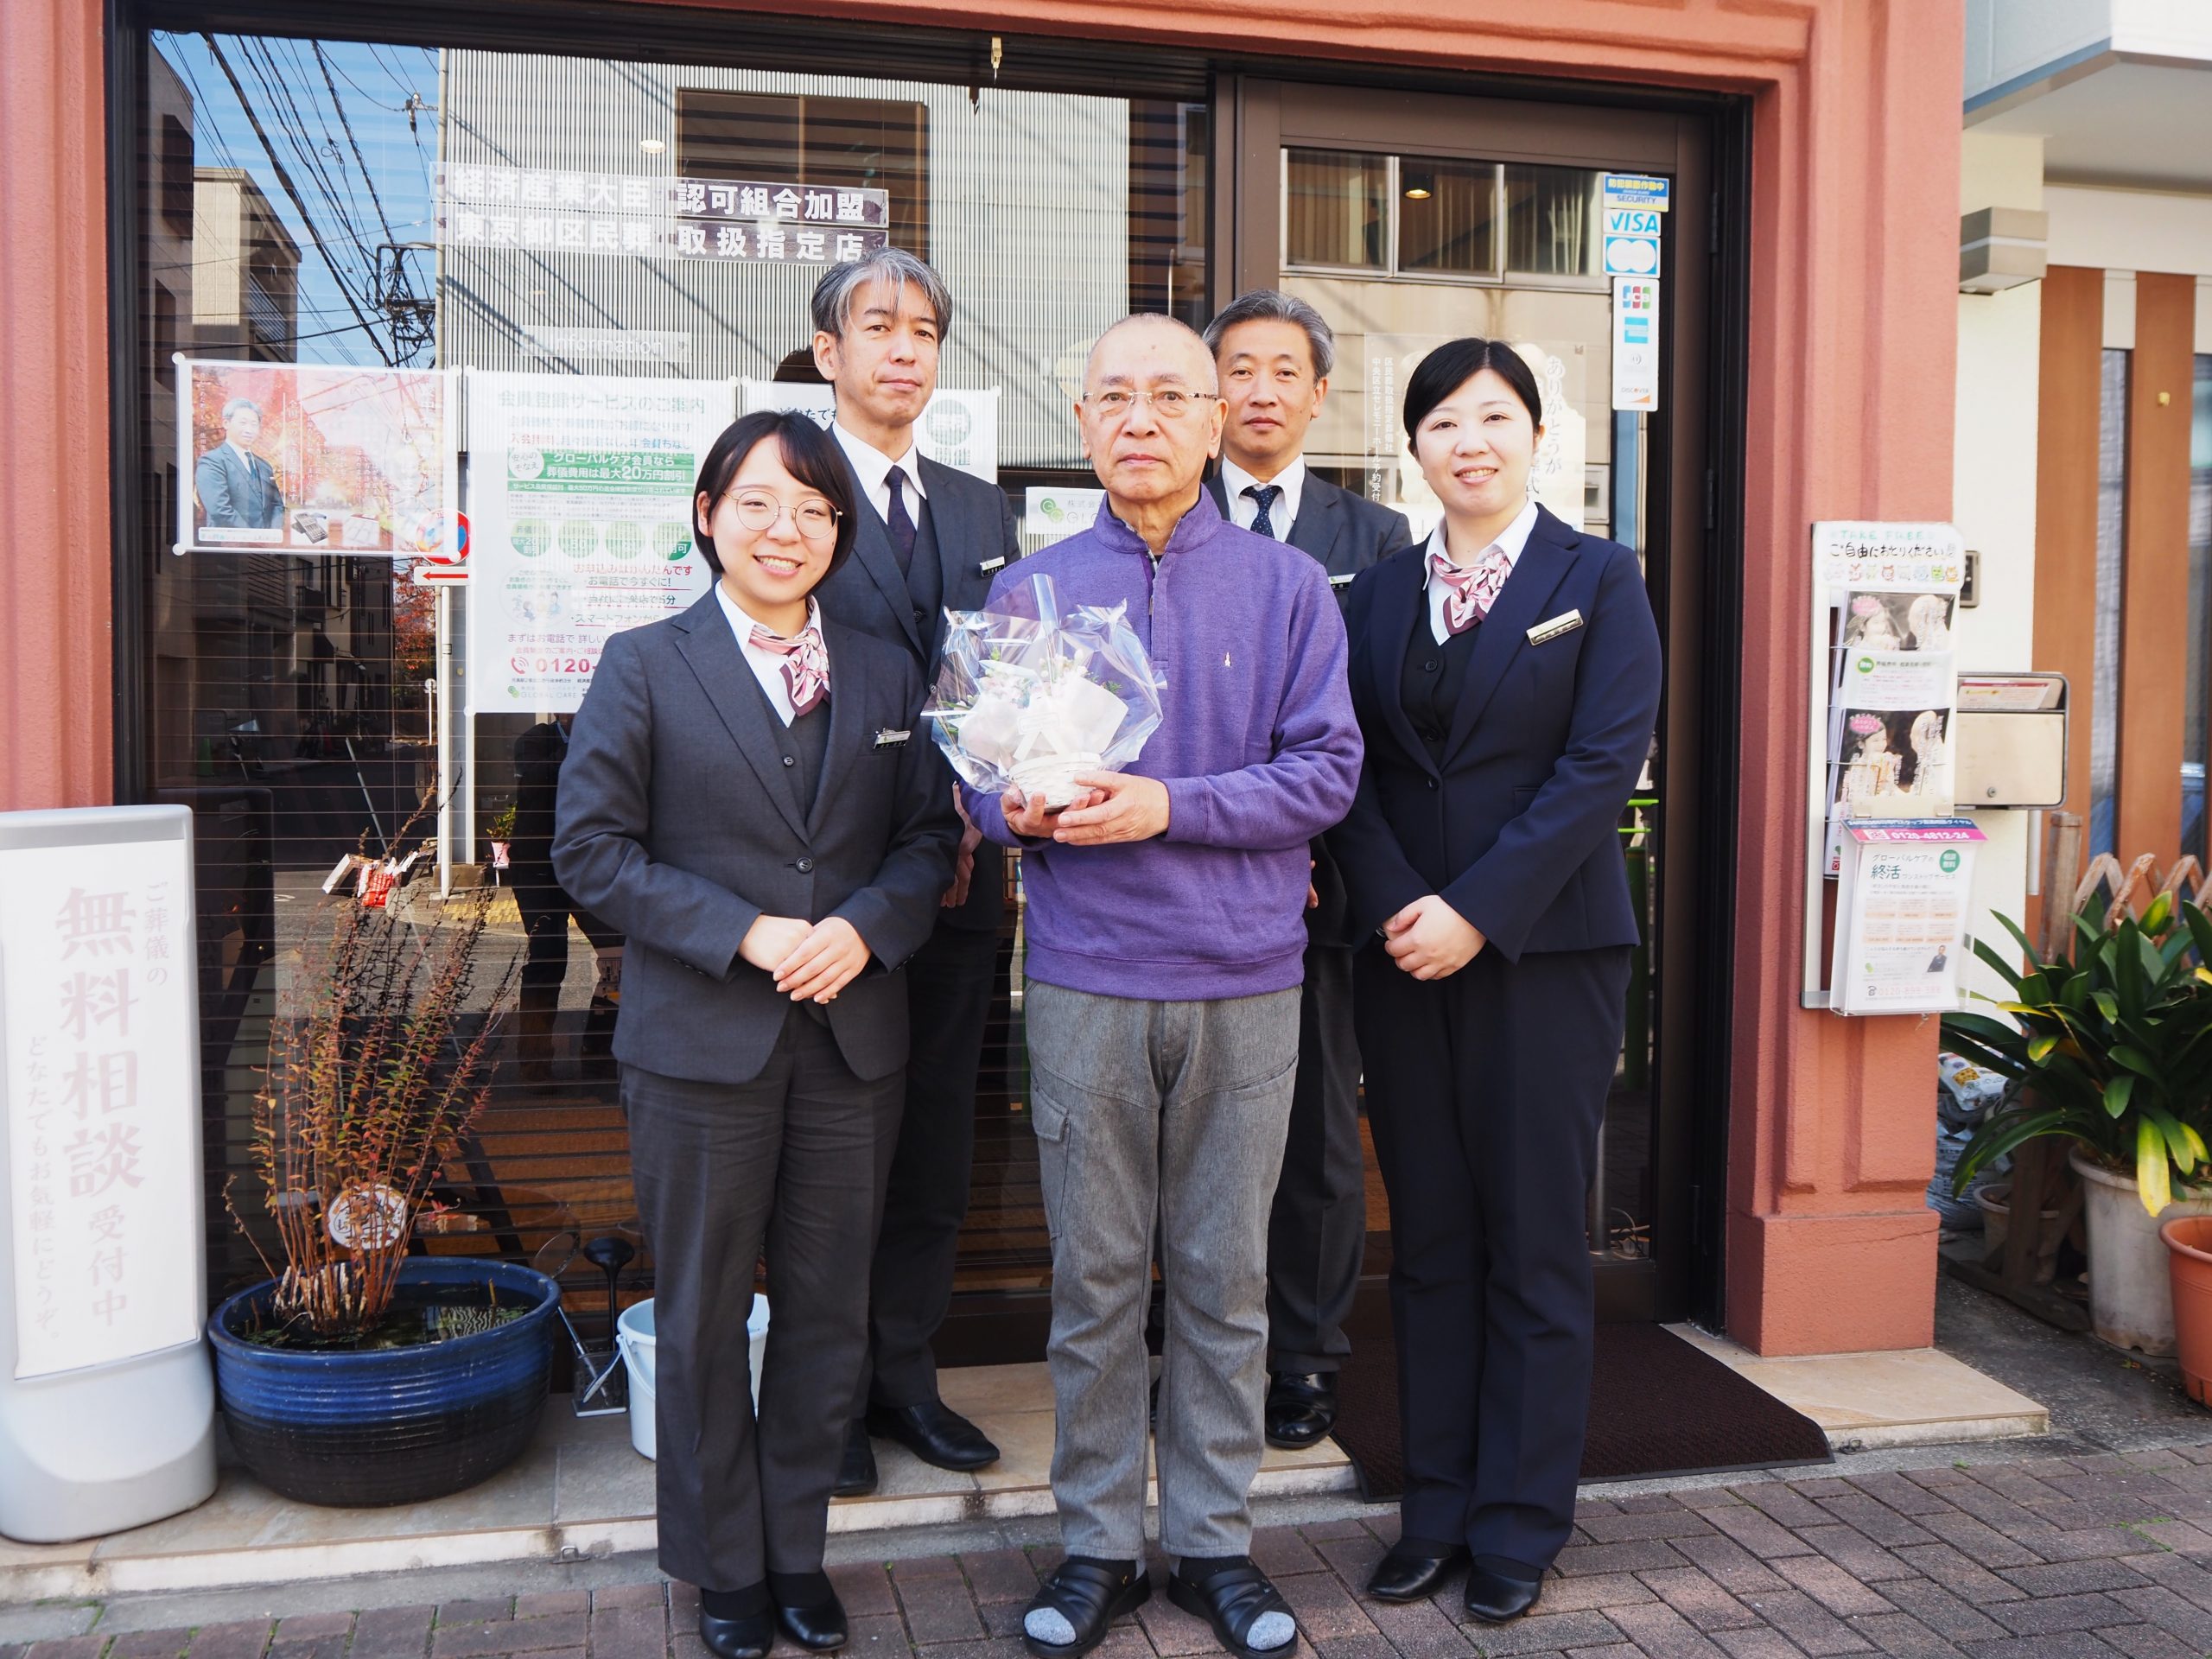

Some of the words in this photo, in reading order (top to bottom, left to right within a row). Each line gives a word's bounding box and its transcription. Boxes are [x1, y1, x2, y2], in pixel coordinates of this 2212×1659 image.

[677, 181, 865, 223] 認可組合加盟
[1617, 194, 1656, 205] SECURITY
[1610, 213, 1658, 232] VISA
[677, 225, 864, 263] 取扱指定店
[1623, 288, 1651, 307] JCB
[1891, 831, 1970, 840] 0120-4812-24
[1870, 864, 1901, 880] 終活
[143, 881, 170, 988] ご葬儀の
[55, 884, 145, 1199] 無料相談
[87, 1203, 129, 1327] 受付中
